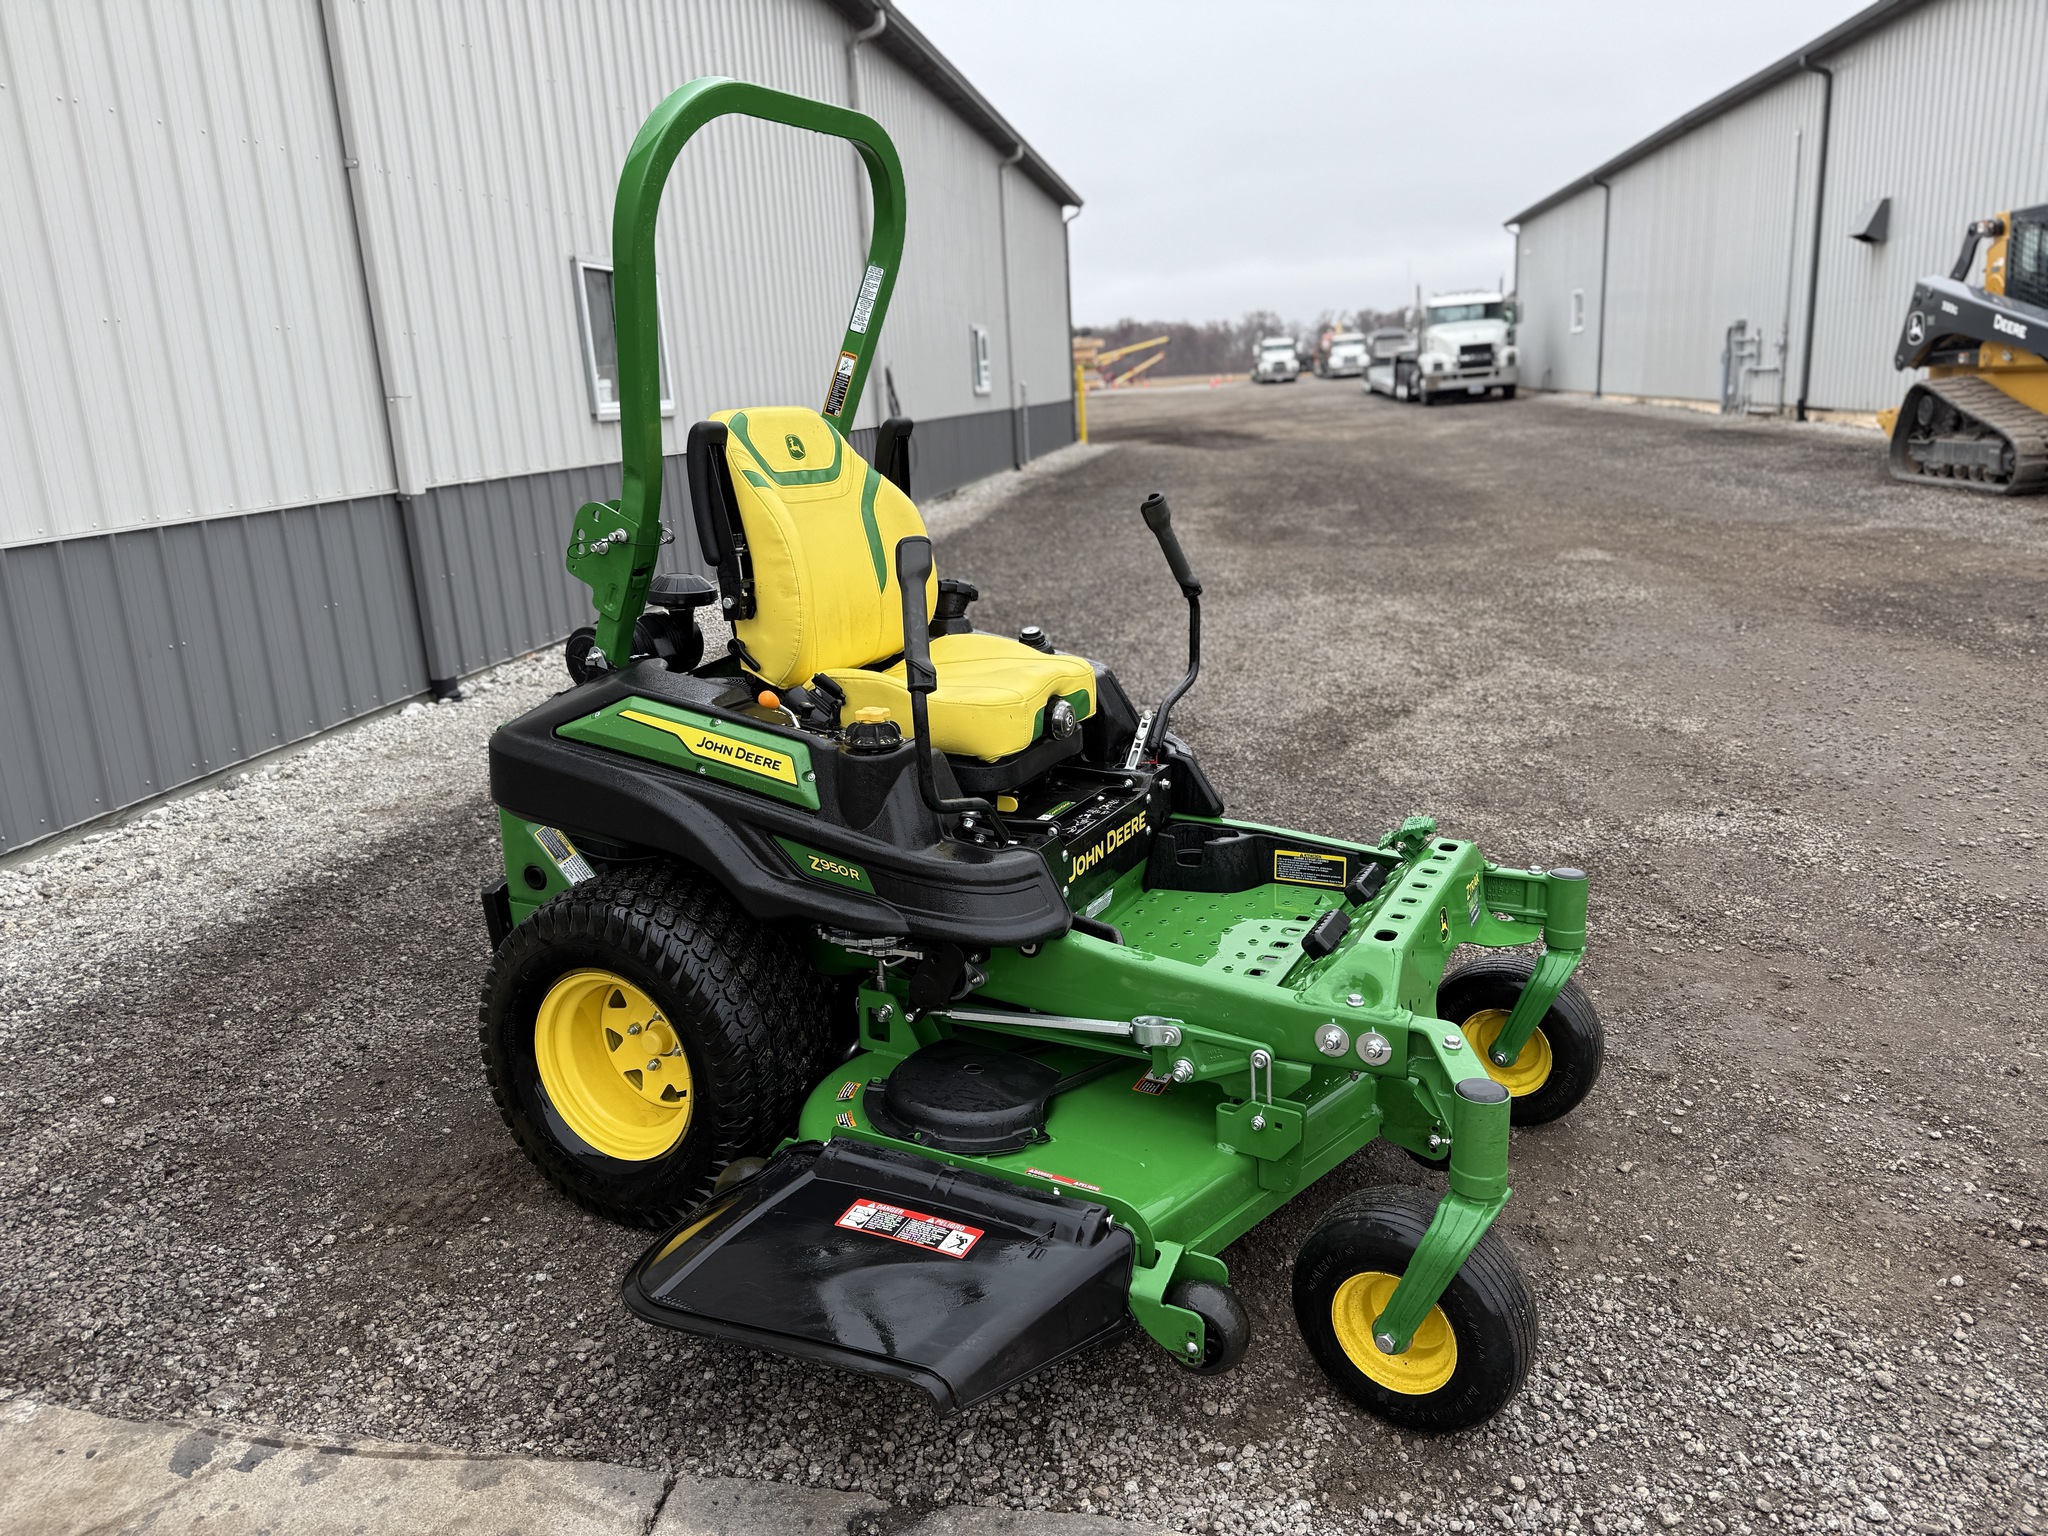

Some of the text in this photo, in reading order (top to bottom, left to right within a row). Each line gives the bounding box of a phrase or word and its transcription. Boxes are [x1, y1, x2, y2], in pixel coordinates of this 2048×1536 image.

[1993, 313, 2028, 340] DEERE
[696, 737, 782, 771] JOHN DEERE
[1068, 840, 1104, 884] JOHN
[1106, 810, 1147, 855] DEERE
[808, 854, 860, 881] Z950R
[876, 1203, 966, 1232] DANGER PELIGRO
